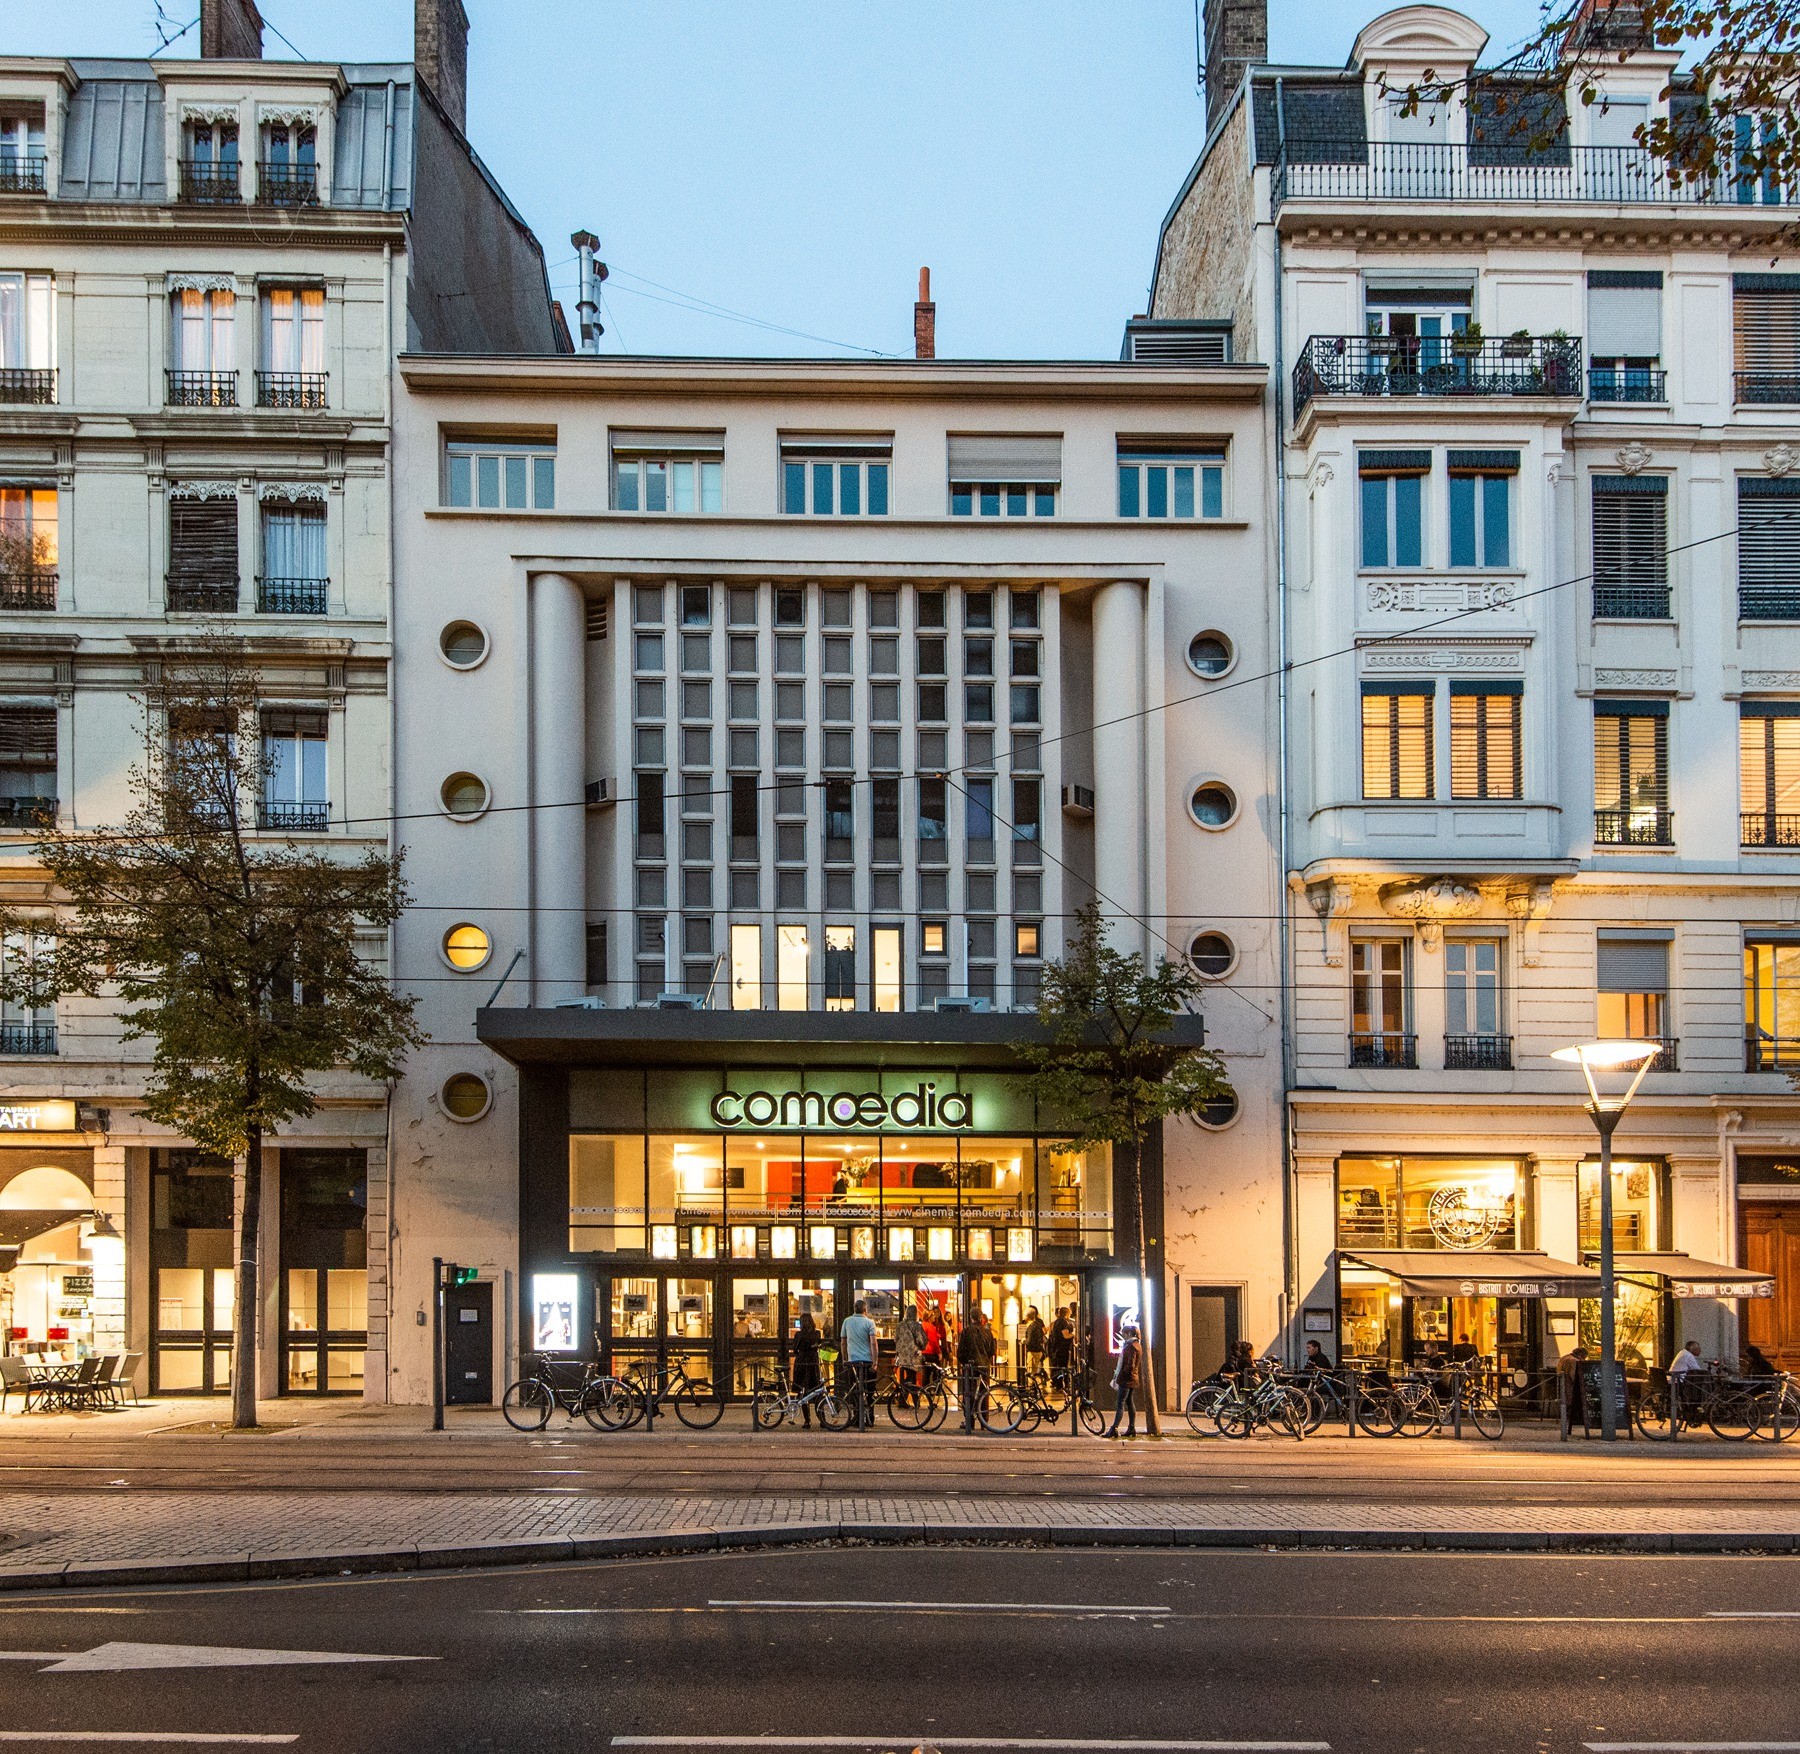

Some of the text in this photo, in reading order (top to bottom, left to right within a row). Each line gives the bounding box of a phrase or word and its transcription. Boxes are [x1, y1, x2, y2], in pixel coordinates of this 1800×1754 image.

[0, 1113, 41, 1129] ART
[1432, 1187, 1460, 1215] AVENUE
[1478, 1283, 1502, 1294] BISTROT
[1692, 1284, 1716, 1295] BISTROT
